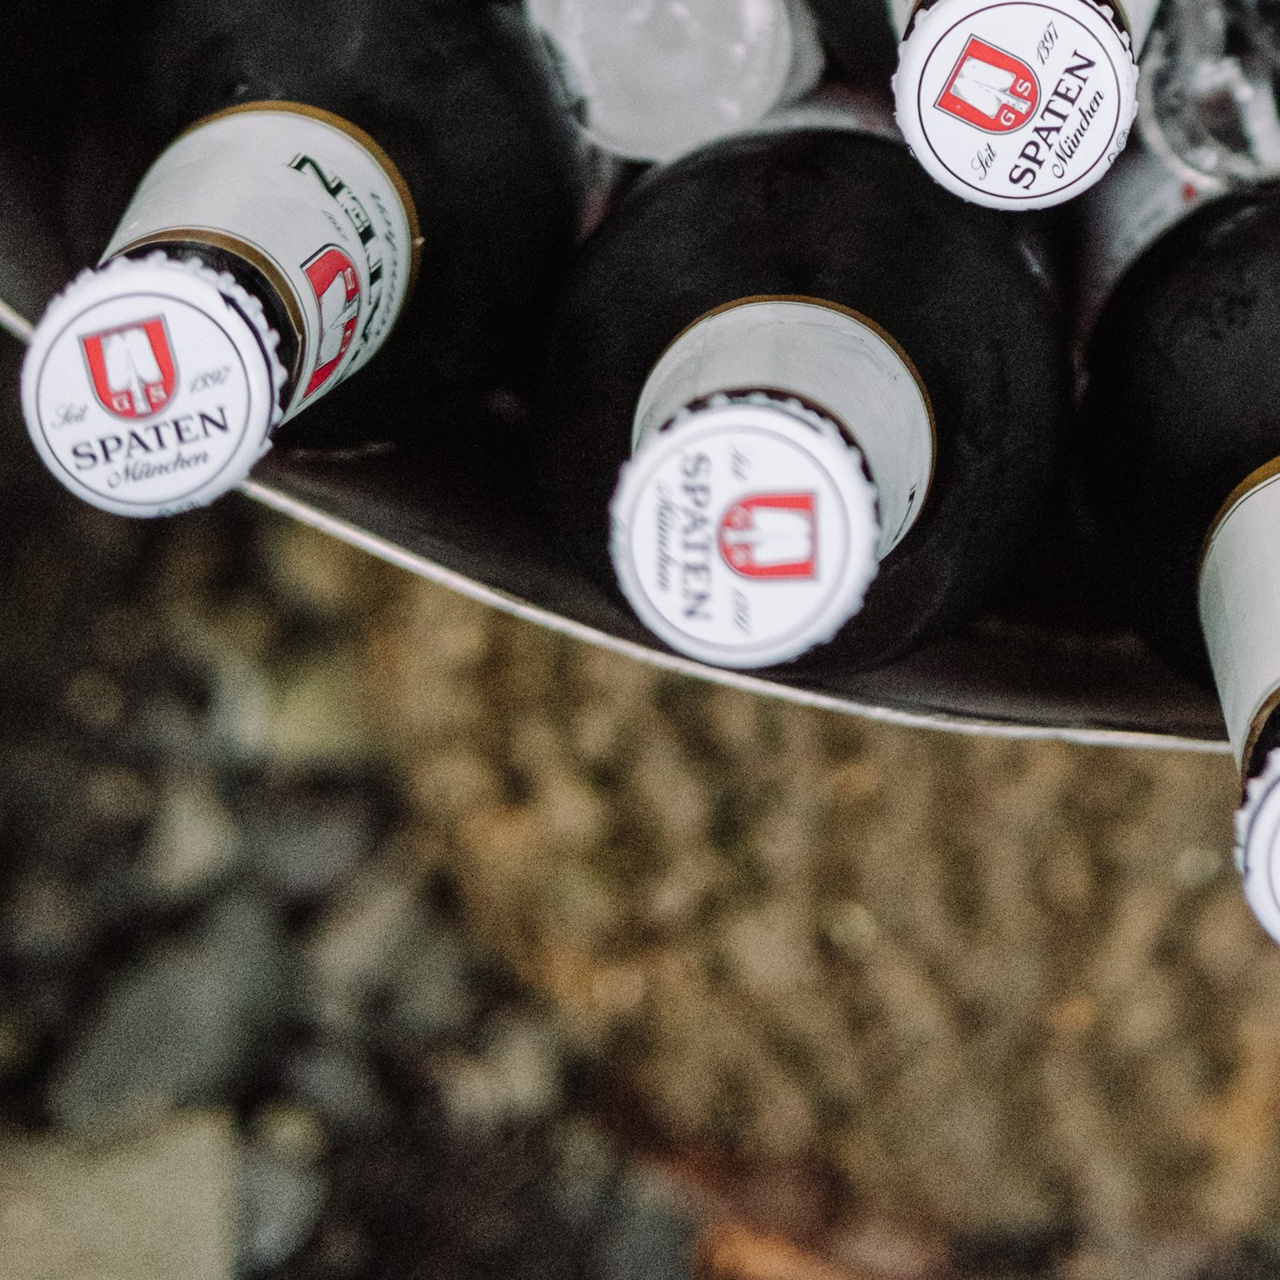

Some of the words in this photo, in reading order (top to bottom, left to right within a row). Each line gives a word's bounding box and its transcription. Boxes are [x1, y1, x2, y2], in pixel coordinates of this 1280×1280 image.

[971, 144, 997, 181] Seit
[1036, 19, 1059, 66] 1397
[1009, 49, 1096, 190] SPATEN
[1051, 90, 1105, 179] München
[71, 406, 230, 471] SPATEN
[106, 453, 210, 489] München
[681, 451, 712, 620] SPATEN
